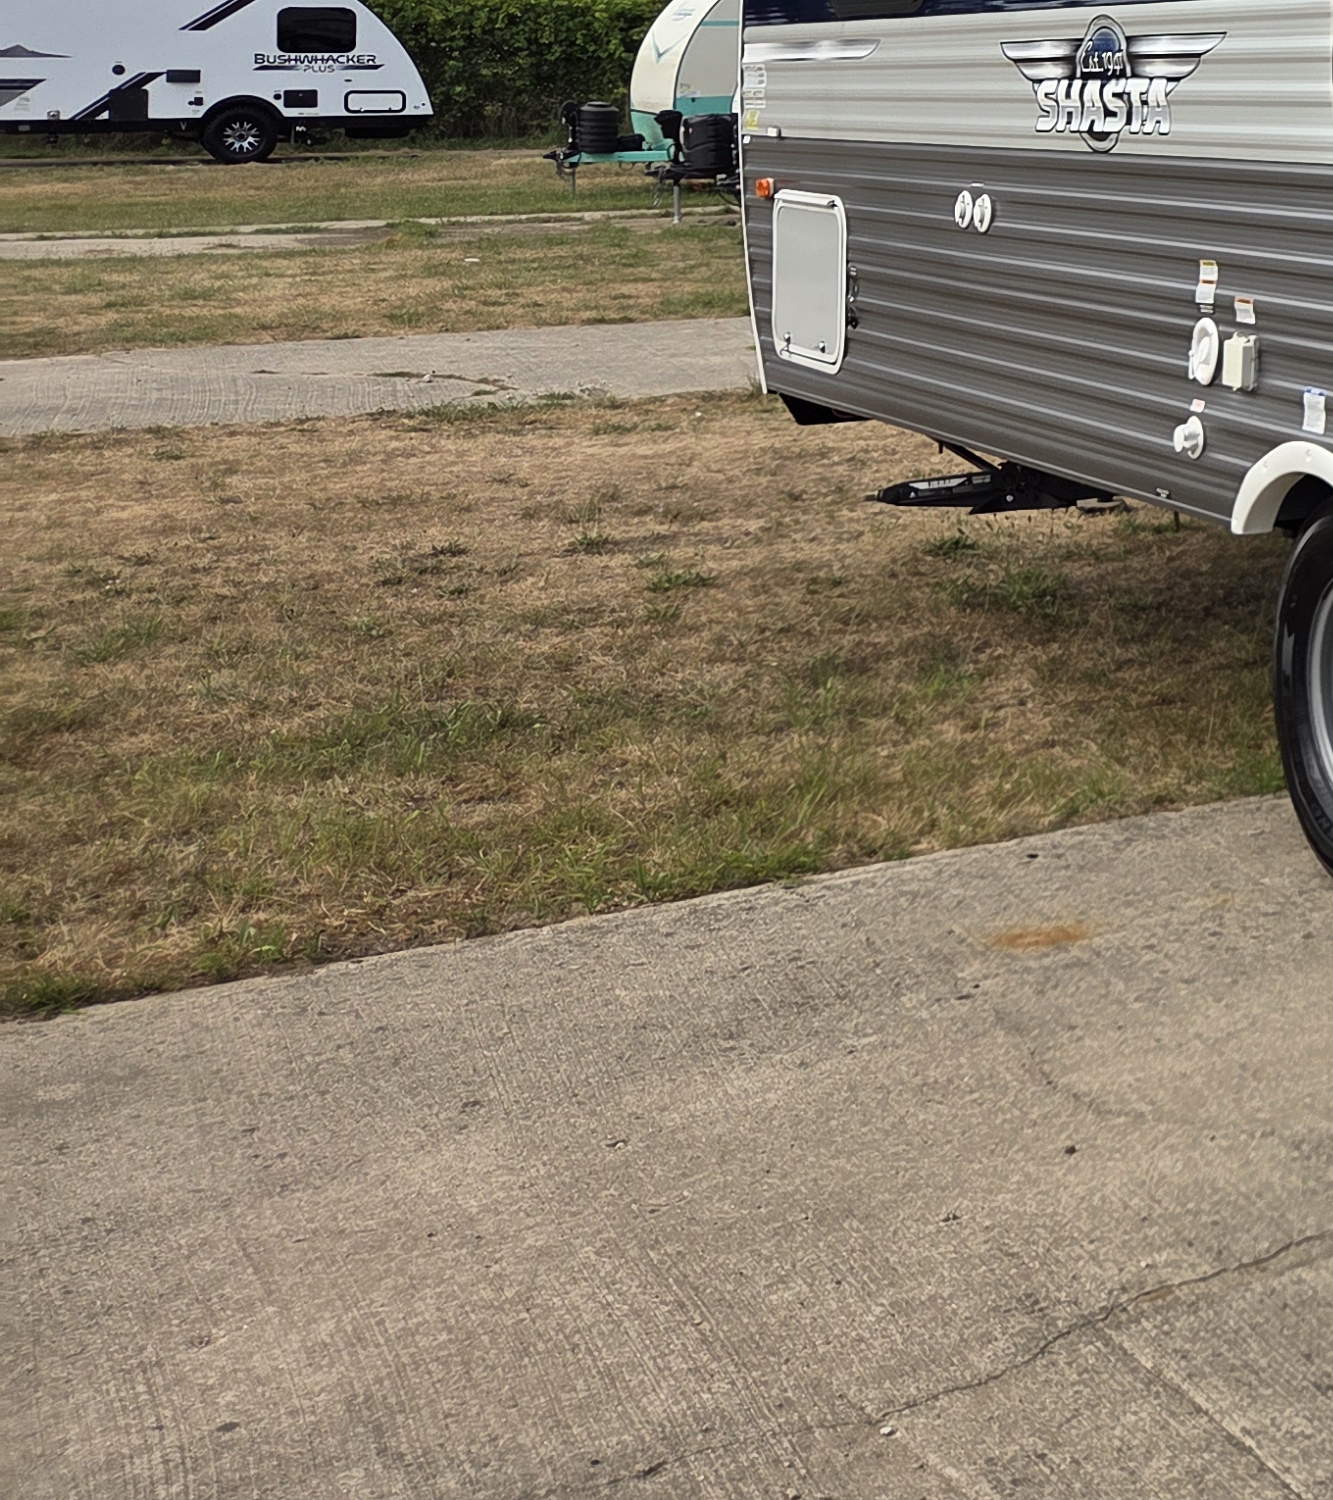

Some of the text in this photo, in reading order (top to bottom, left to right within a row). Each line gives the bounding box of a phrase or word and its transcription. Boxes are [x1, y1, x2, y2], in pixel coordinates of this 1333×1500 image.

[254, 53, 377, 65] BUSHWHACKER
[303, 65, 335, 73] PLUS
[1035, 78, 1171, 135] SHASTA
